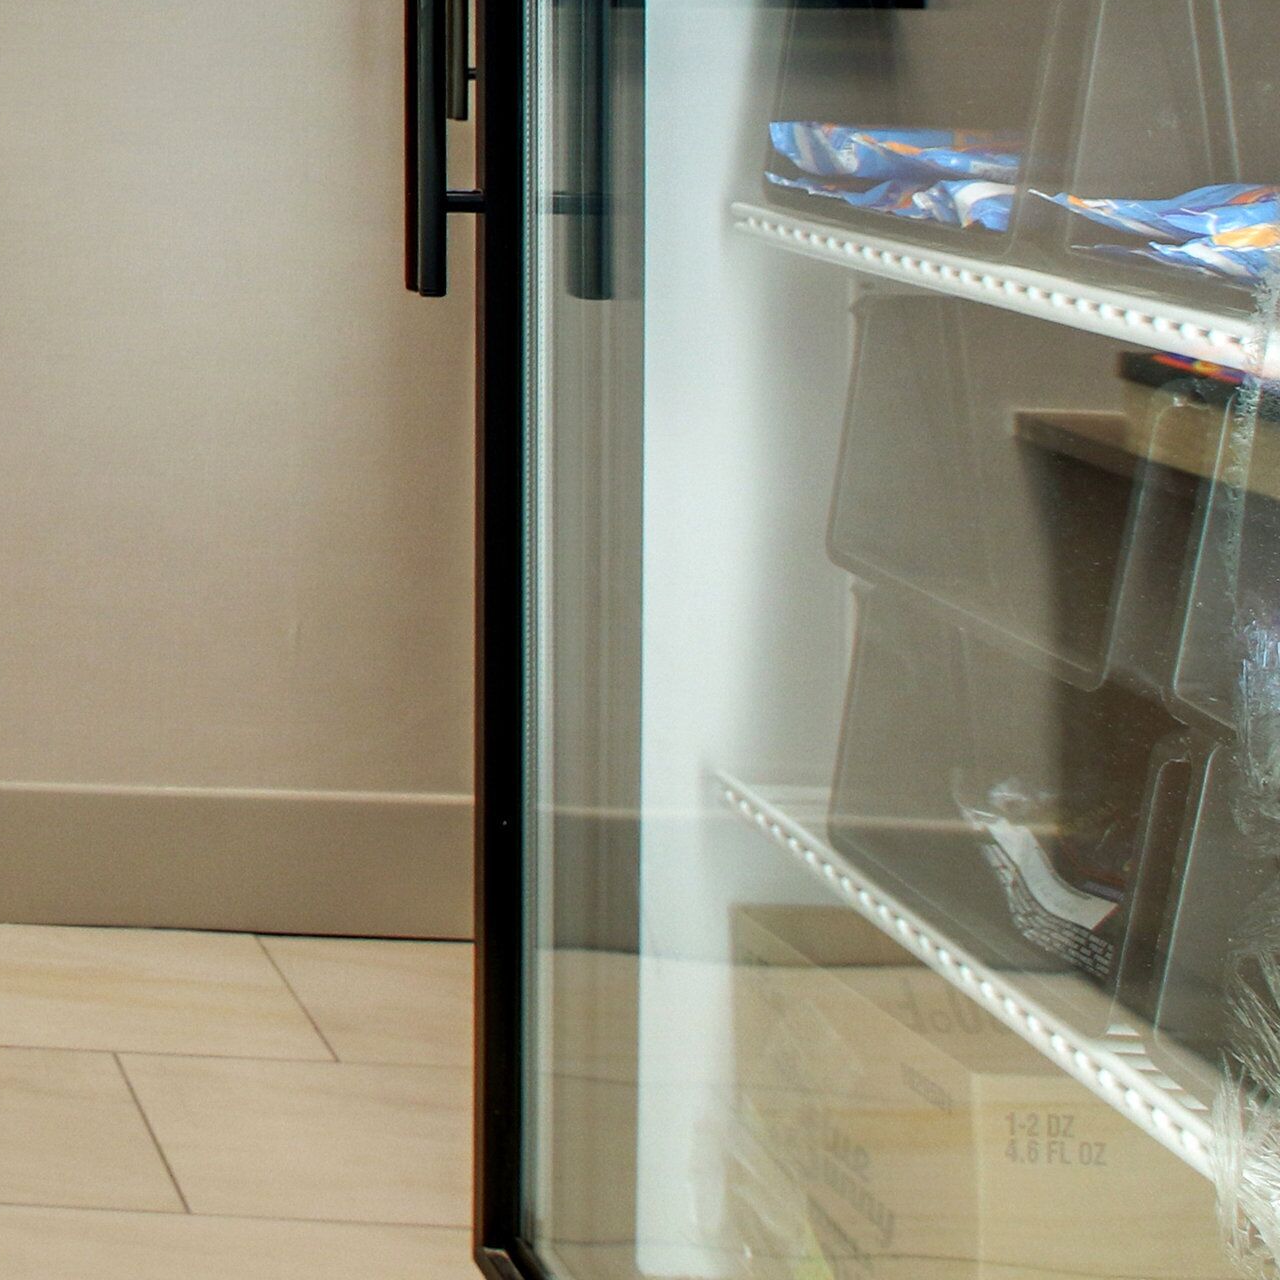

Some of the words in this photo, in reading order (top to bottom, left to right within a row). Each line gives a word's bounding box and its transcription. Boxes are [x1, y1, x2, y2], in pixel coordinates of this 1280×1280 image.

[1004, 1110, 1041, 1137] 1-2
[1046, 1112, 1076, 1138] DZ
[1045, 1140, 1073, 1166] FL
[1078, 1140, 1109, 1167] OZ
